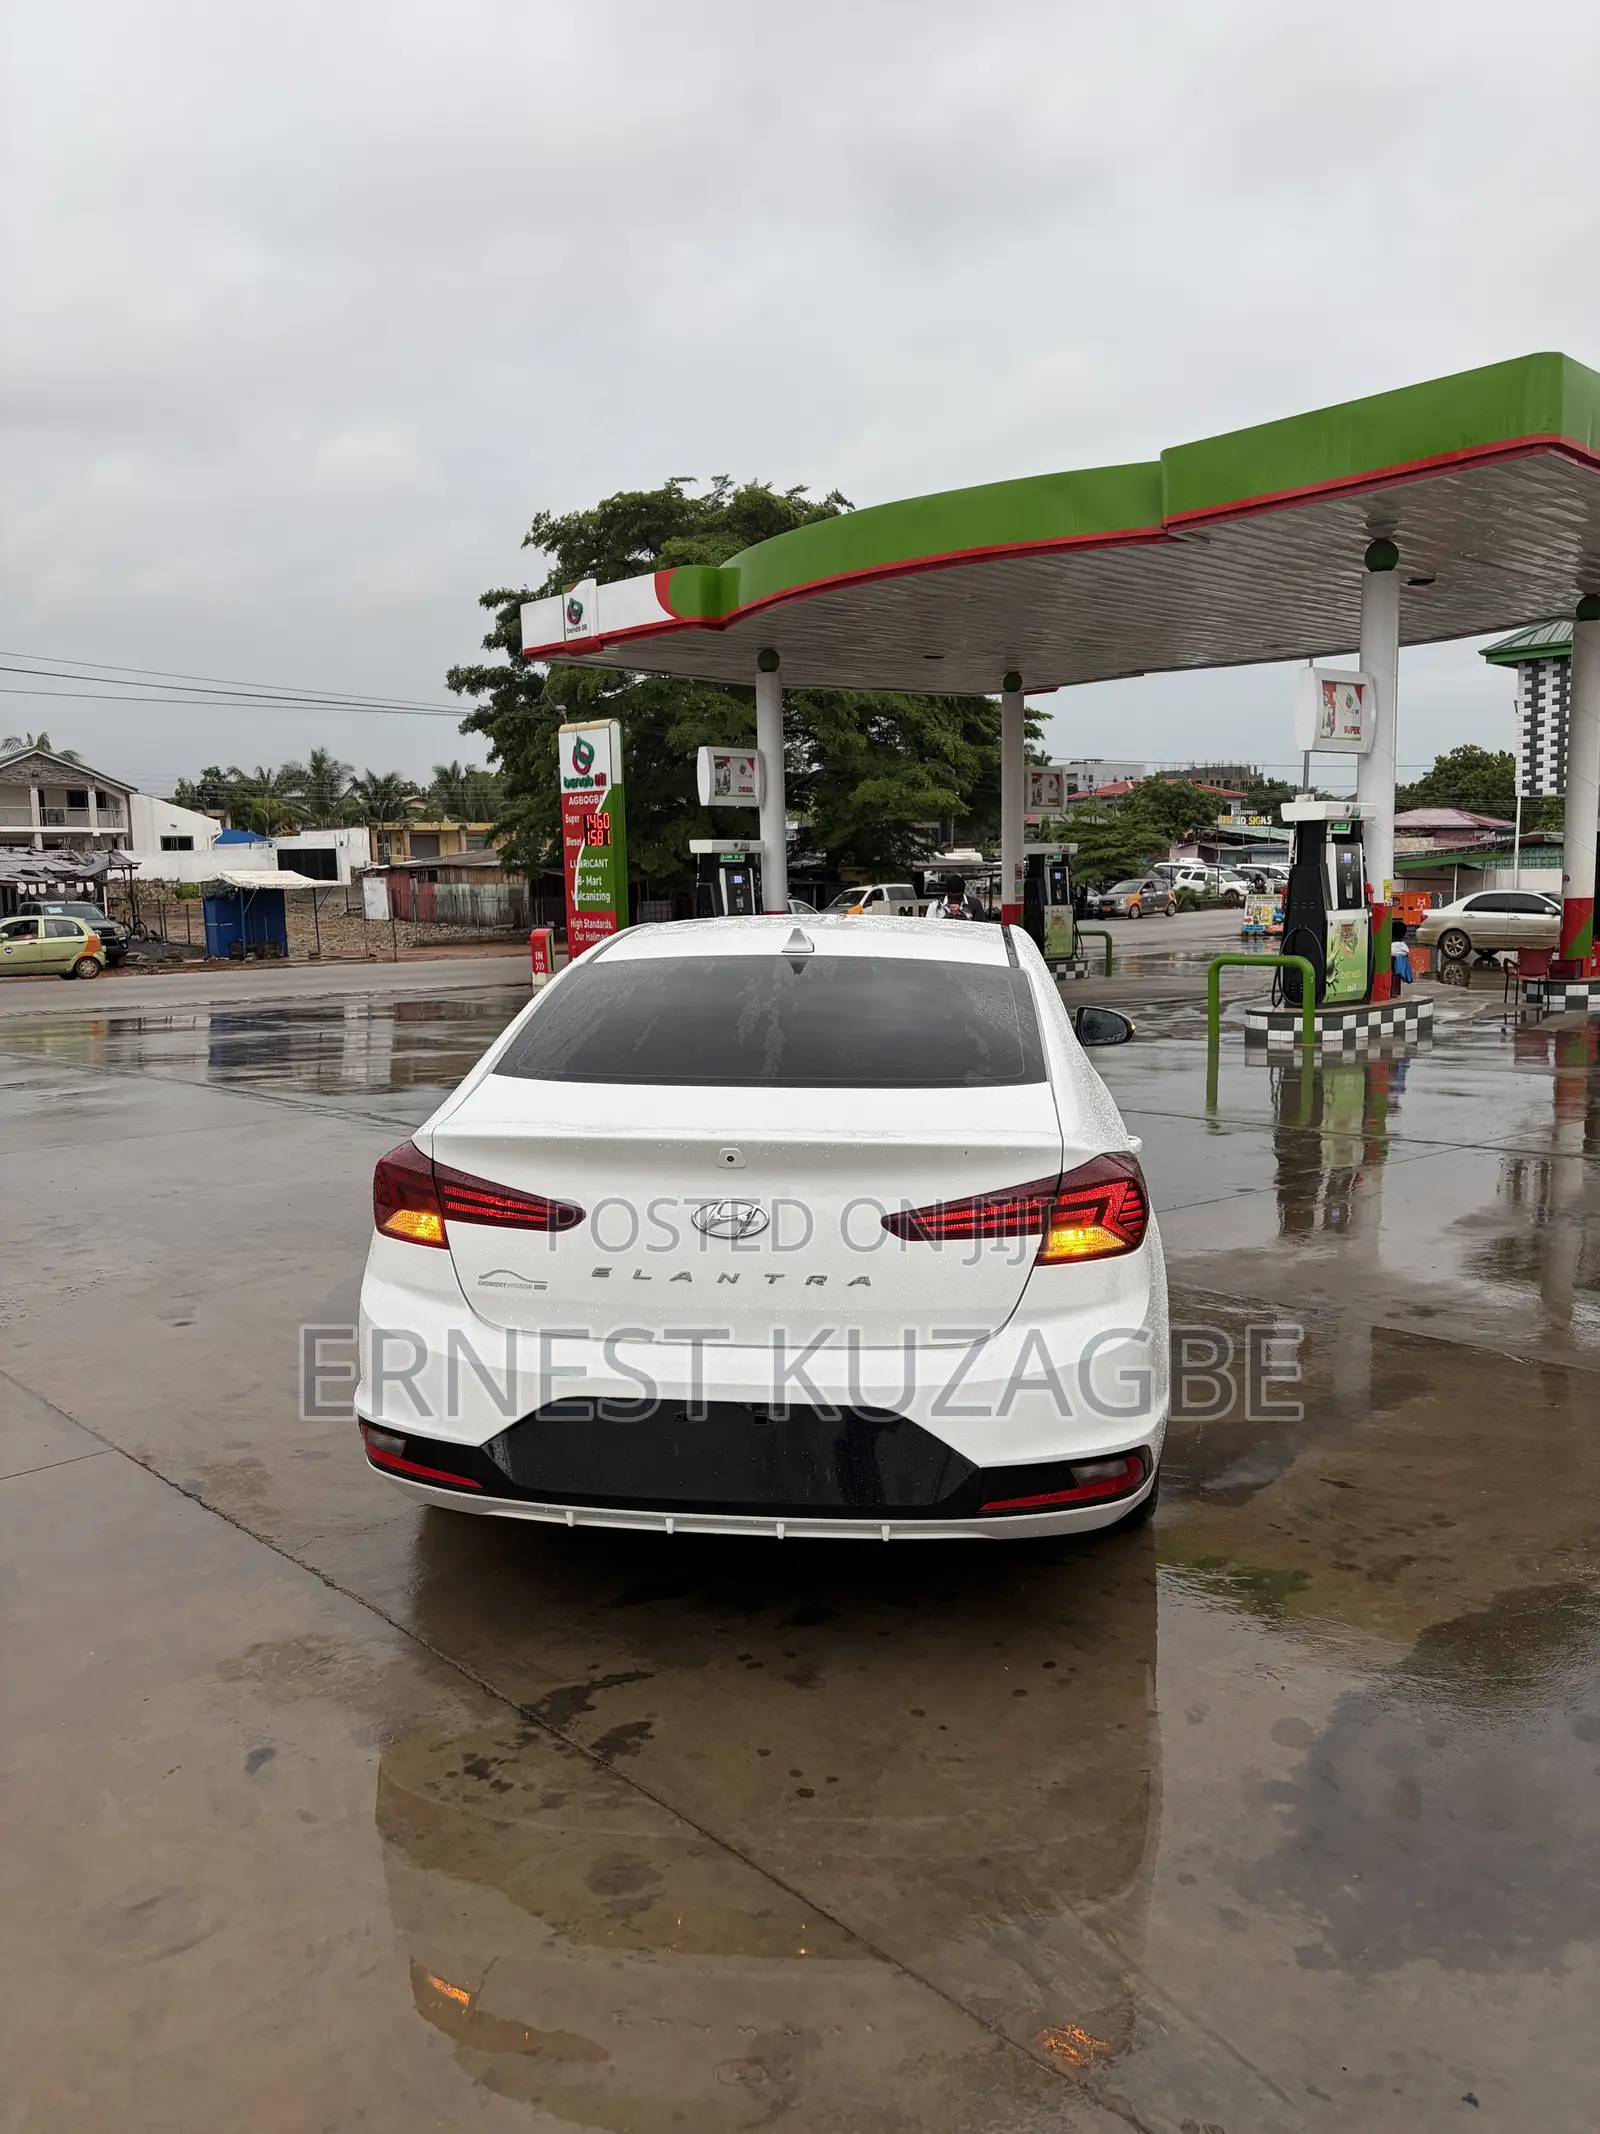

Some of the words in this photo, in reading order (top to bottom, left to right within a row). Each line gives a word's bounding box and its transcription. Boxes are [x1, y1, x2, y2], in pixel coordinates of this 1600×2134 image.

[1344, 725, 1361, 735] SUPER
[563, 775, 593, 789] benab
[565, 813, 580, 826] Super
[1235, 816, 1247, 825] 3D
[1248, 816, 1272, 825] SIGNS
[565, 836, 582, 847] Diesel
[569, 859, 608, 869] LUBRICANT
[586, 875, 602, 886] Mart
[571, 890, 611, 903] Vulcanizing
[570, 918, 583, 930] High
[574, 931, 585, 942] Our
[535, 951, 544, 960] IN
[591, 1267, 871, 1287] ELANTRA
